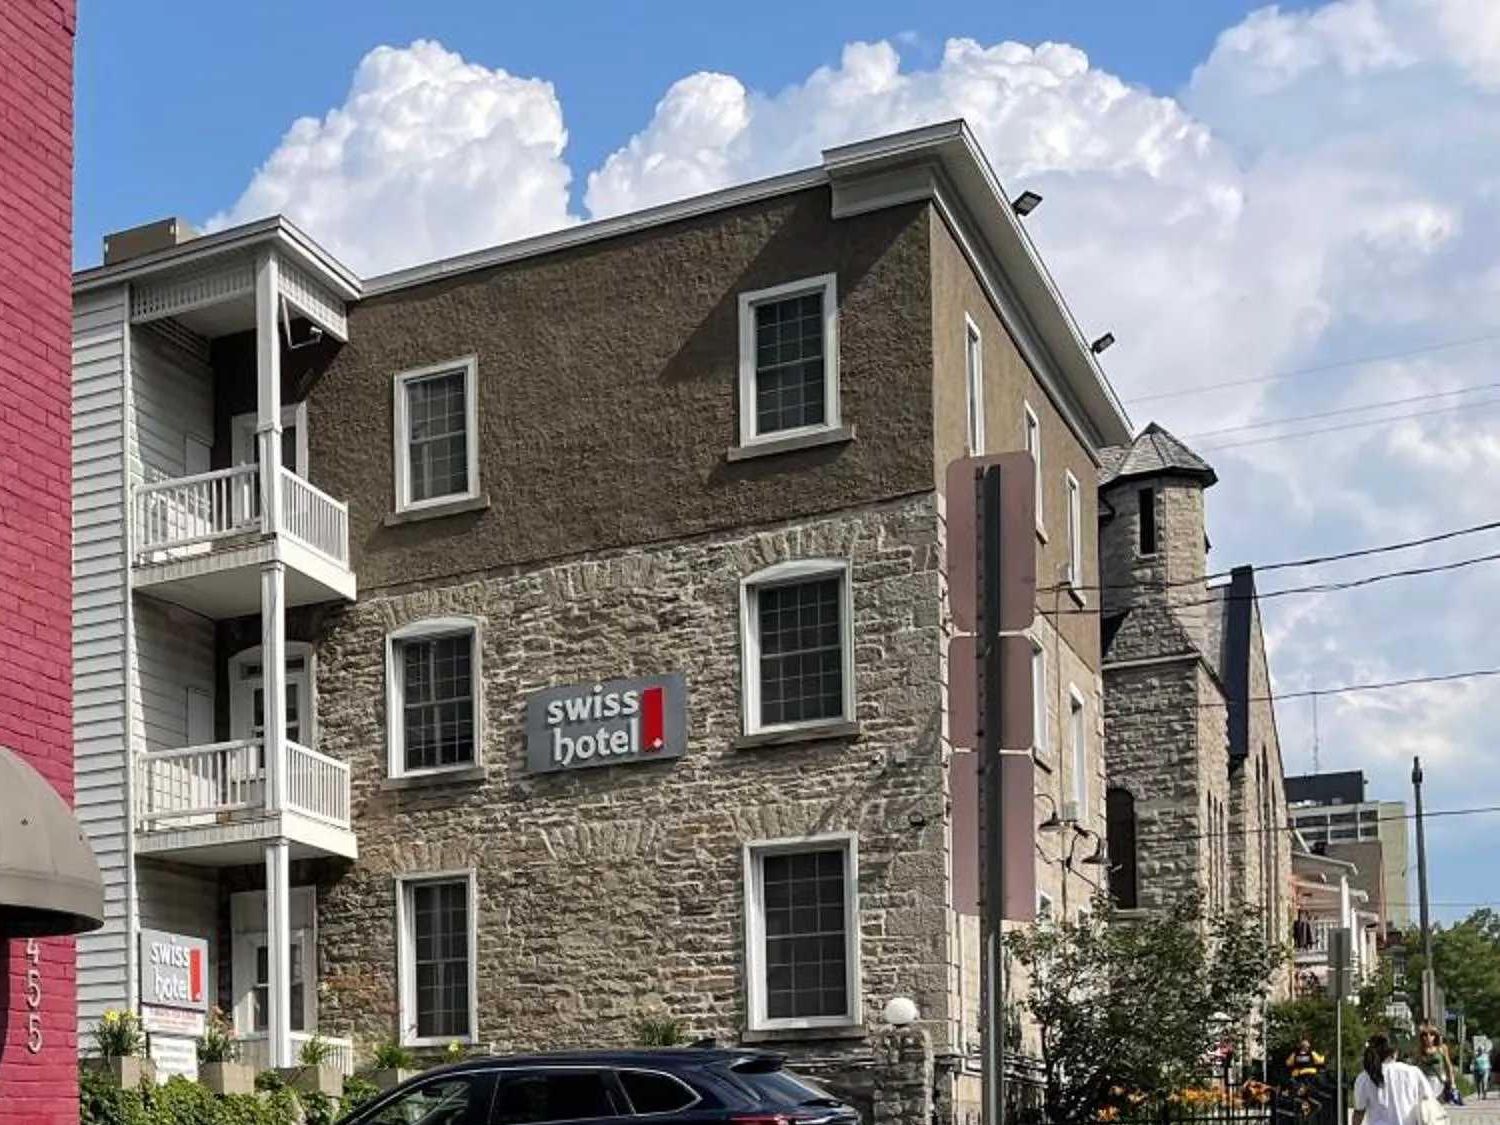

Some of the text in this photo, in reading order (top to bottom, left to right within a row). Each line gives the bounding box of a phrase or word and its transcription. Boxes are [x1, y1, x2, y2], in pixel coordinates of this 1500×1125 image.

[547, 684, 639, 724] swiss
[553, 717, 639, 767] hotel
[150, 935, 190, 968] swiss
